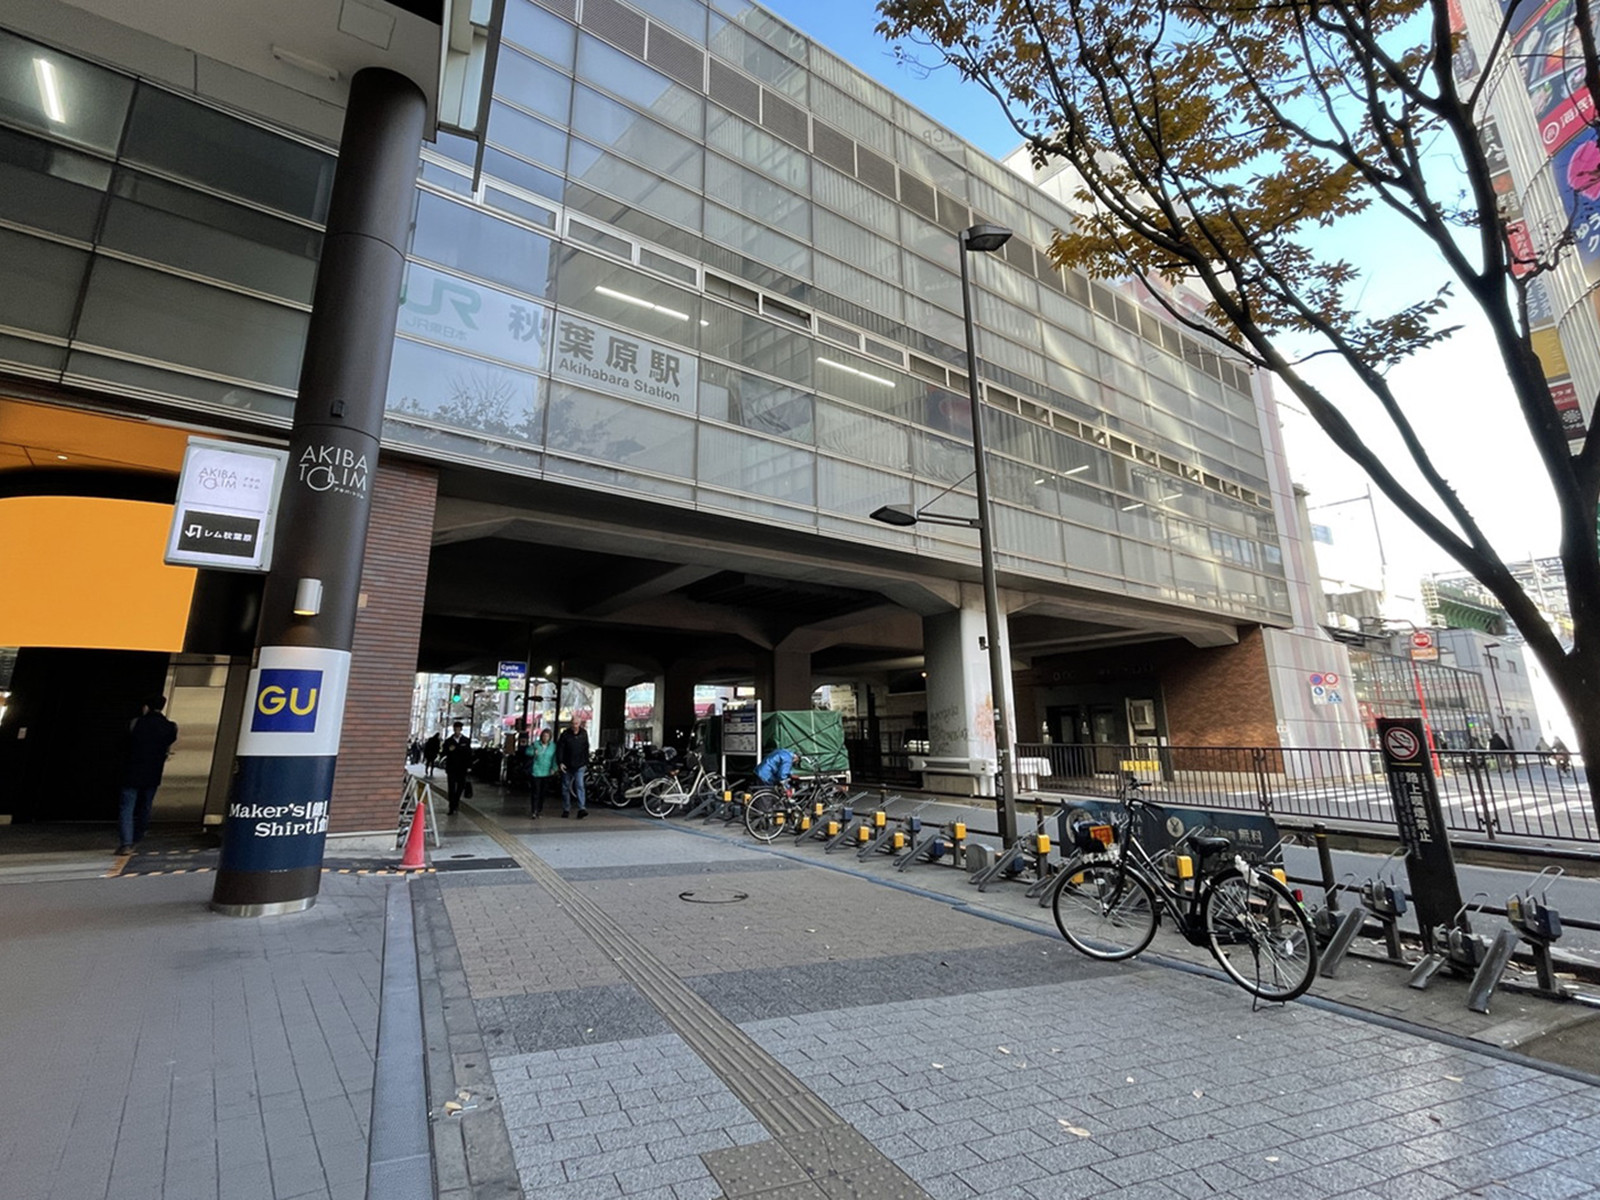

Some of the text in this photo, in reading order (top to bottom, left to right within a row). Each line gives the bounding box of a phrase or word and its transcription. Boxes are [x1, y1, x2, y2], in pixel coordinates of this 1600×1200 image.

[399, 278, 482, 331] JR
[405, 316, 468, 341] JR東日本
[508, 303, 682, 389] 秋葉原駅
[559, 357, 681, 403] Akihabara Station
[199, 467, 237, 480] AKIBA
[300, 445, 368, 474] AKIBA
[258, 685, 317, 716] GU
[229, 803, 305, 818] Maker's
[254, 821, 313, 837] Shirt
